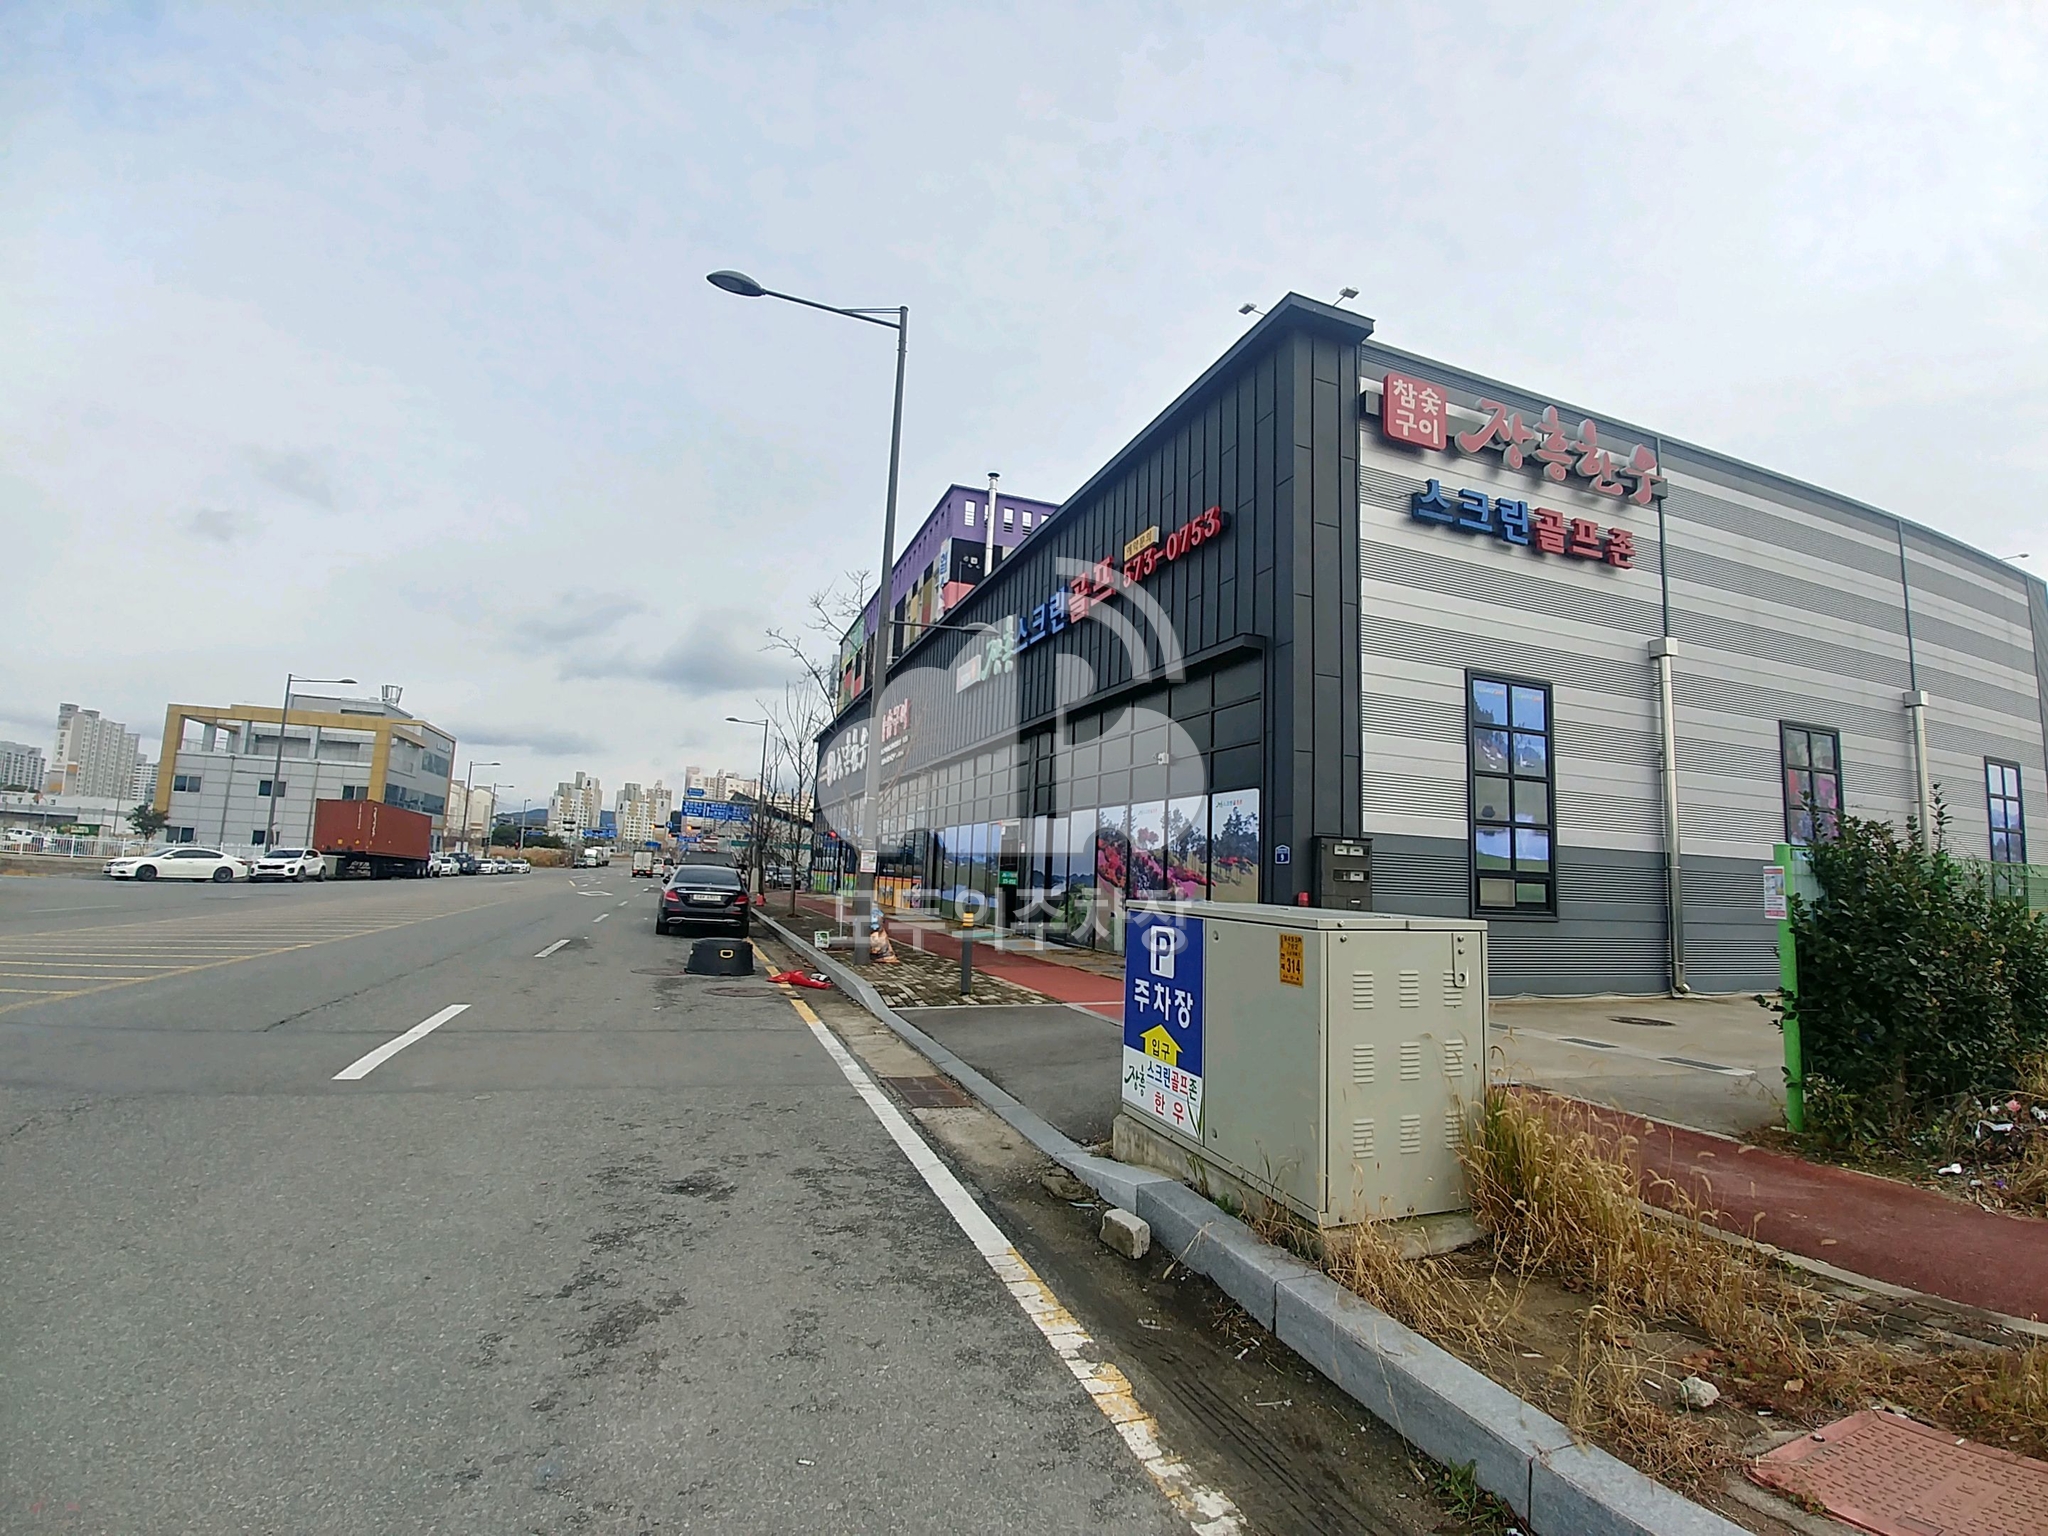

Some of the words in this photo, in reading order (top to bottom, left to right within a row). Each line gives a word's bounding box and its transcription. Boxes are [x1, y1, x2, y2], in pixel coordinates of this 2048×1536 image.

[1395, 410, 1439, 444] 구이
[1412, 478, 1636, 569] 스크린골프존
[1123, 506, 1221, 588] 573-0753
[1155, 930, 1171, 971] P
[1286, 957, 1301, 975] 314
[1134, 978, 1194, 1029] 주차장
[1152, 1039, 1170, 1060] 입구
